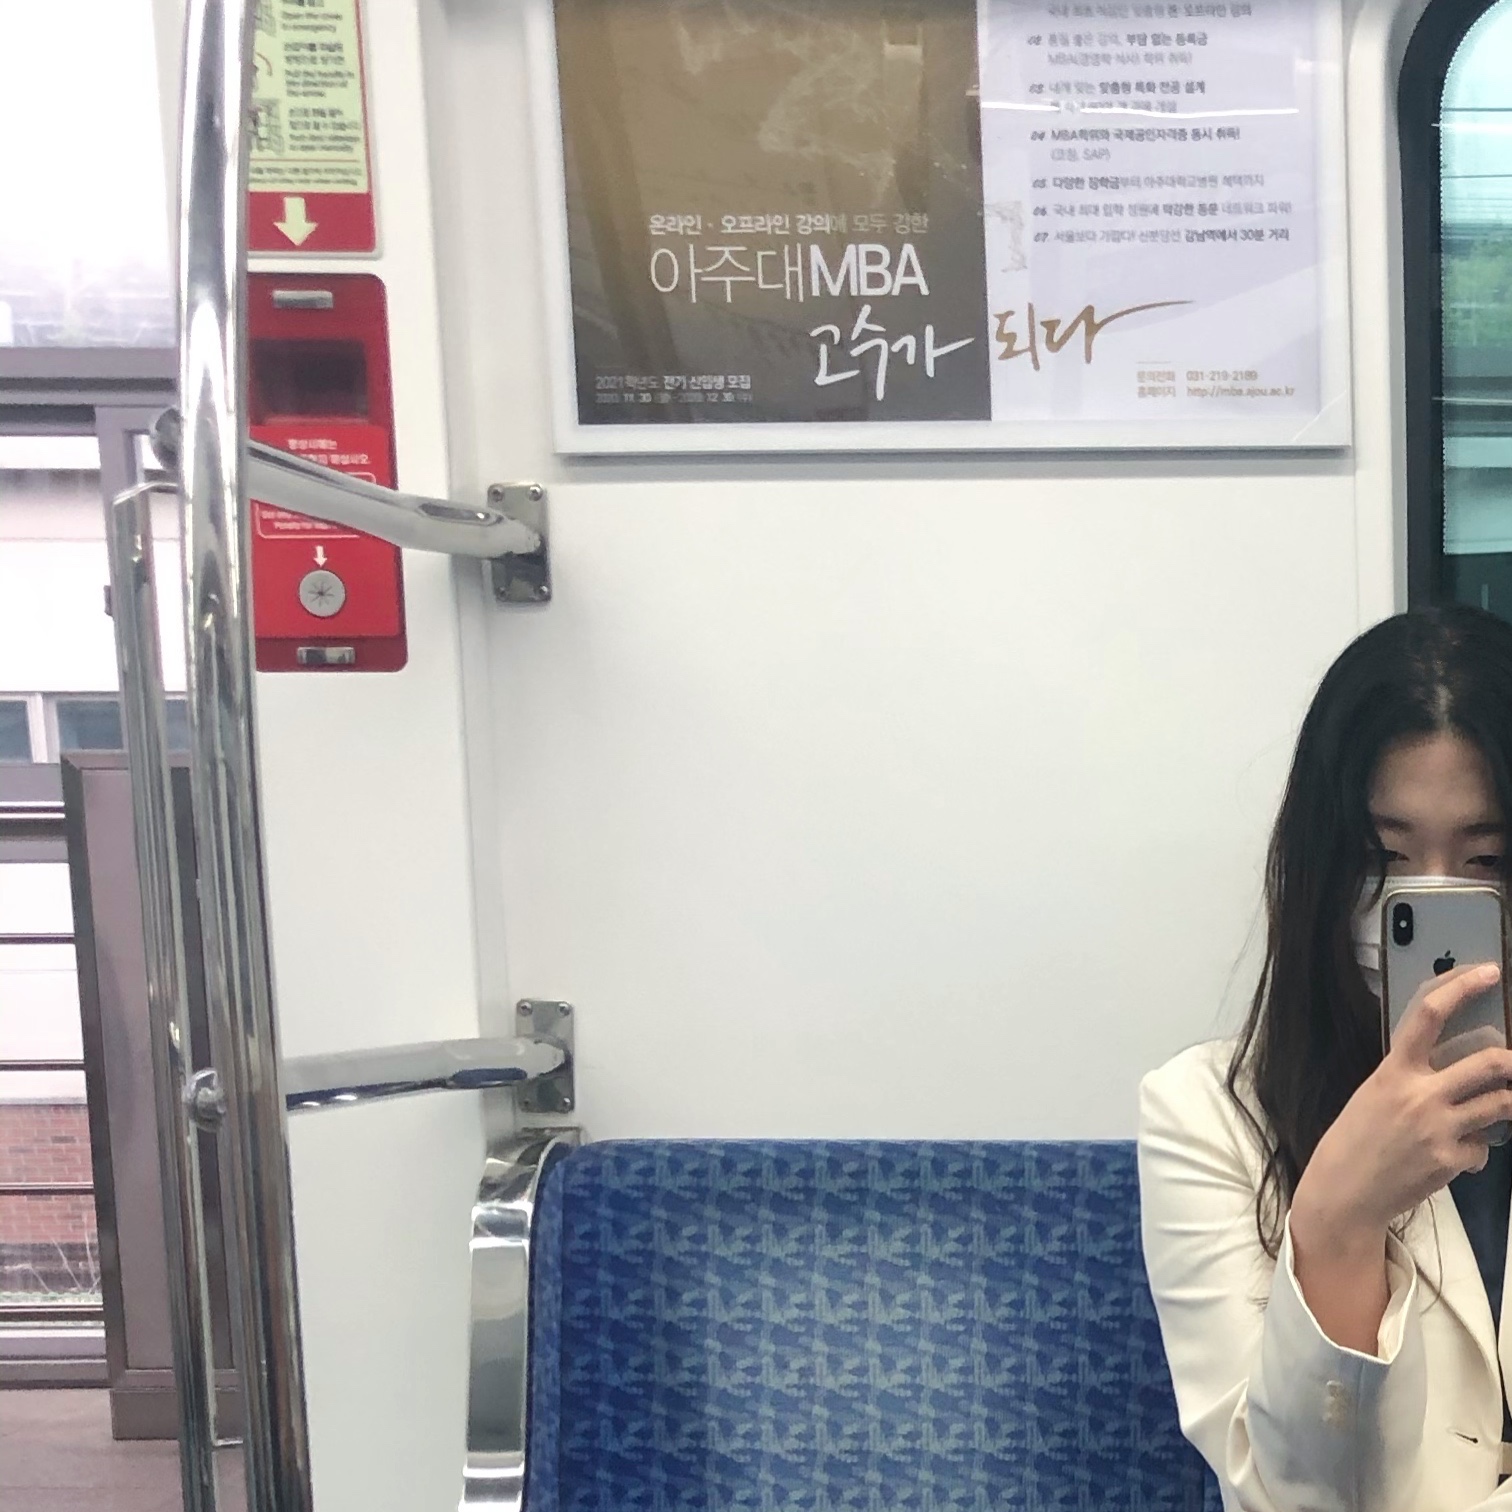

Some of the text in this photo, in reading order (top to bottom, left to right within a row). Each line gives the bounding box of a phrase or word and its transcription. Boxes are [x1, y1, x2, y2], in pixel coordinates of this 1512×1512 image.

[649, 213, 702, 235] 온라인
[721, 213, 790, 235] 오프라인
[853, 213, 888, 235] 모두
[891, 213, 929, 235] 강한
[650, 243, 929, 303] 아주대MBA
[810, 300, 1194, 401] 고수가 되다
